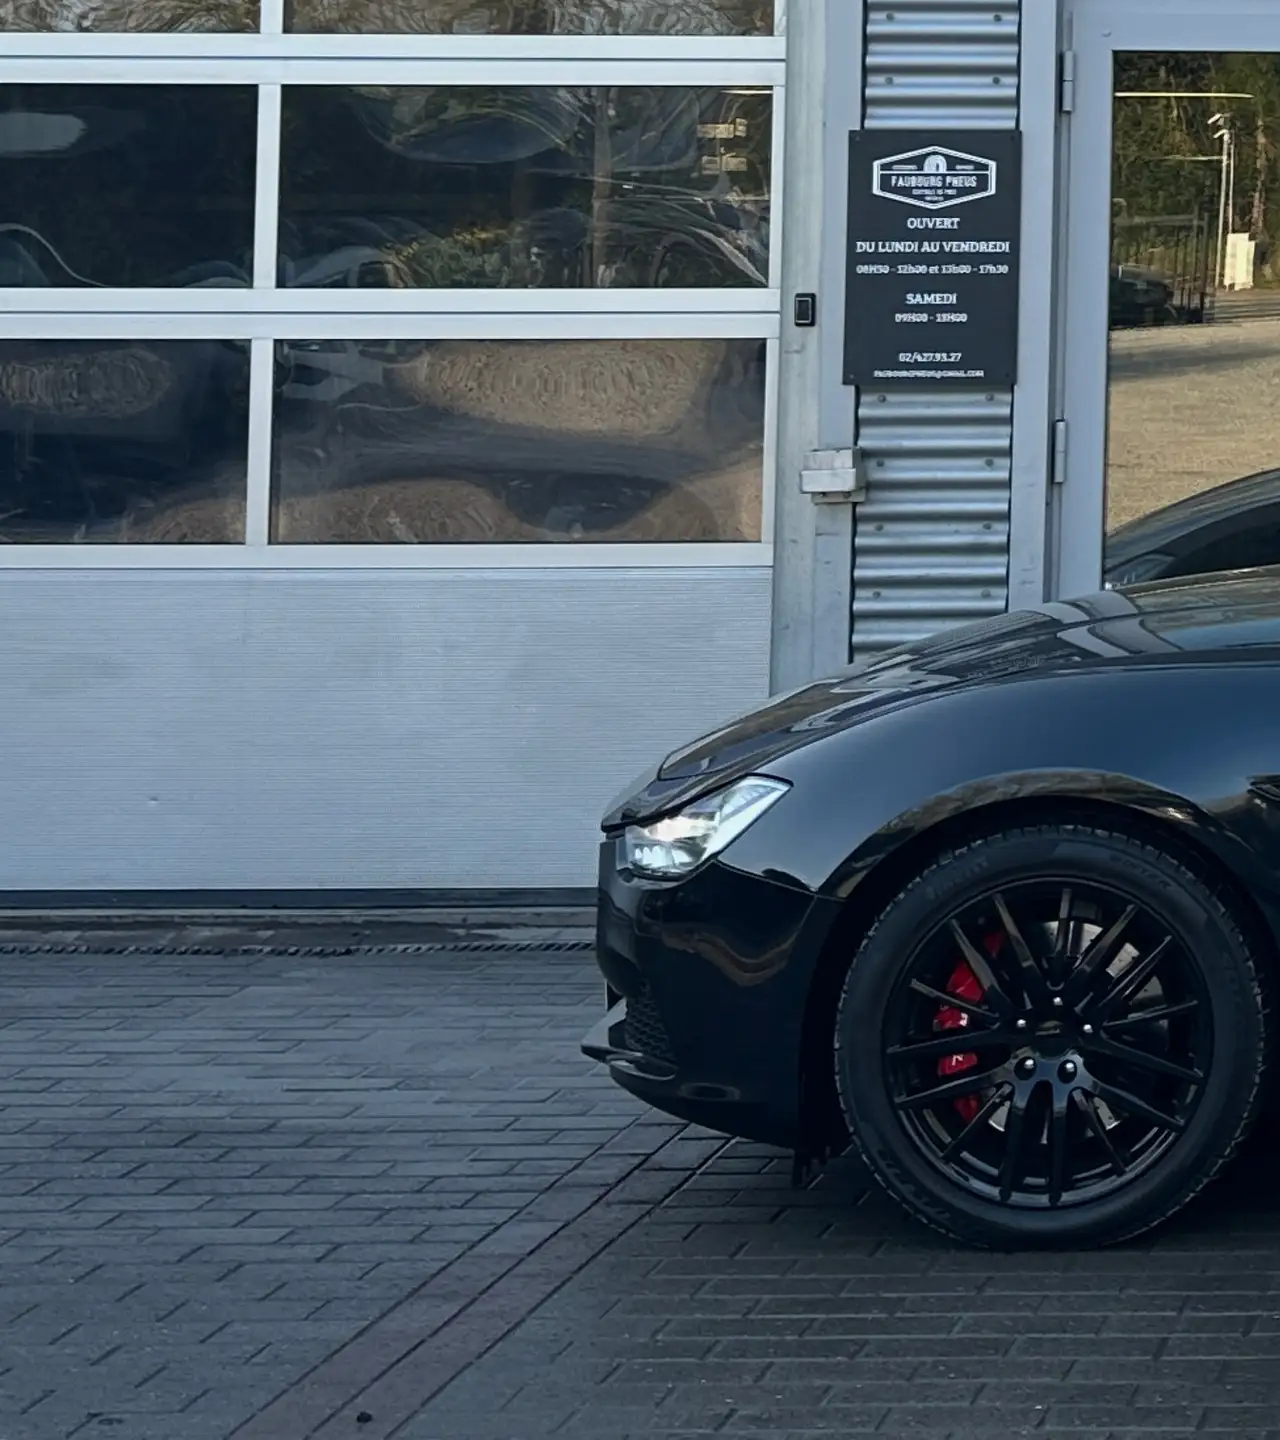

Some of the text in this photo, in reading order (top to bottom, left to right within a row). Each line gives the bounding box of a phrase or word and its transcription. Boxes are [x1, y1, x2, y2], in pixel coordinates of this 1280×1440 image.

[946, 175, 977, 188] PNEUS
[907, 217, 960, 229] OUVERT
[856, 241, 1010, 253] DU LUNDI AU VENDREDI
[929, 265, 940, 274] et
[906, 293, 957, 304] SAMEDI
